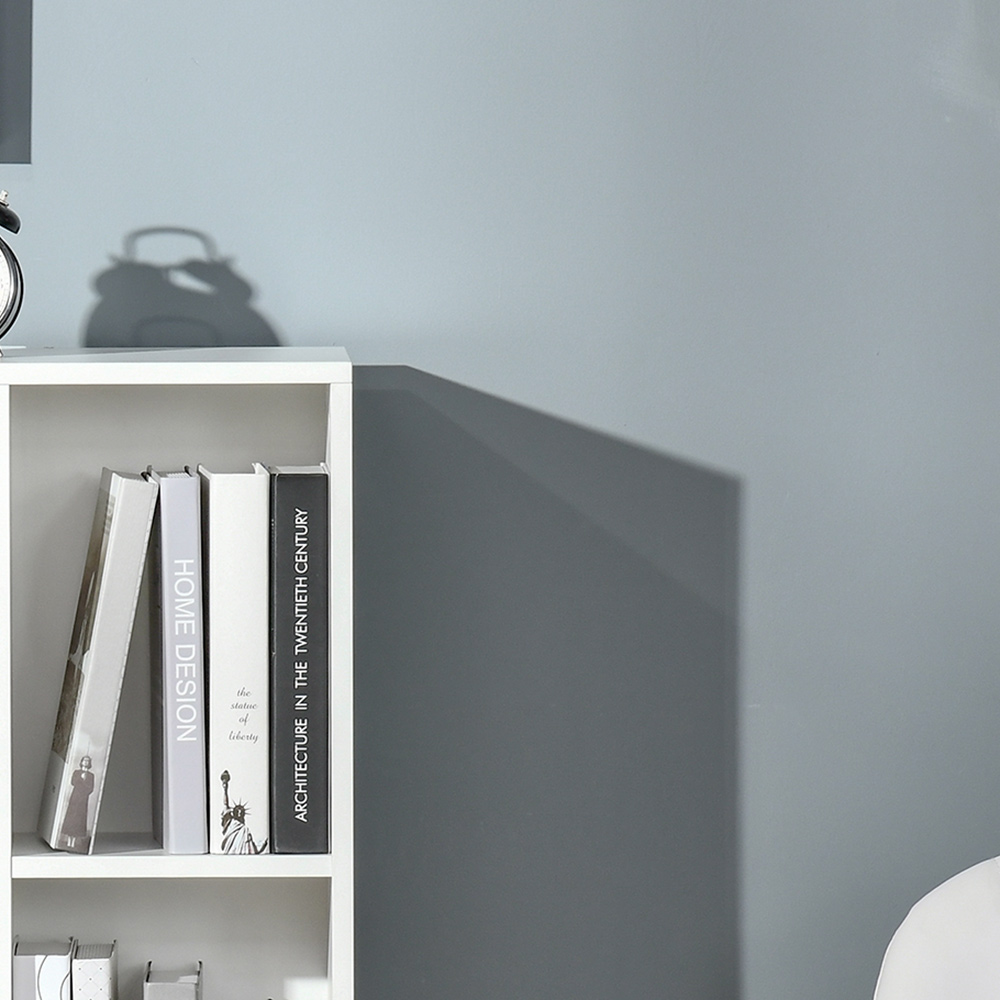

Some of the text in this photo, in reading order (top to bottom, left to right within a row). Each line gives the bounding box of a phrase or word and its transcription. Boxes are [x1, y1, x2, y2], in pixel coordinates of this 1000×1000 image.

[173, 558, 197, 742] HOME DESIGN
[294, 508, 309, 823] ARCHITECTURE IN THE TWENTIETH CENTURY
[236, 687, 252, 697] the
[230, 702, 258, 710] statue
[238, 713, 249, 726] of
[228, 730, 259, 744] liberty
